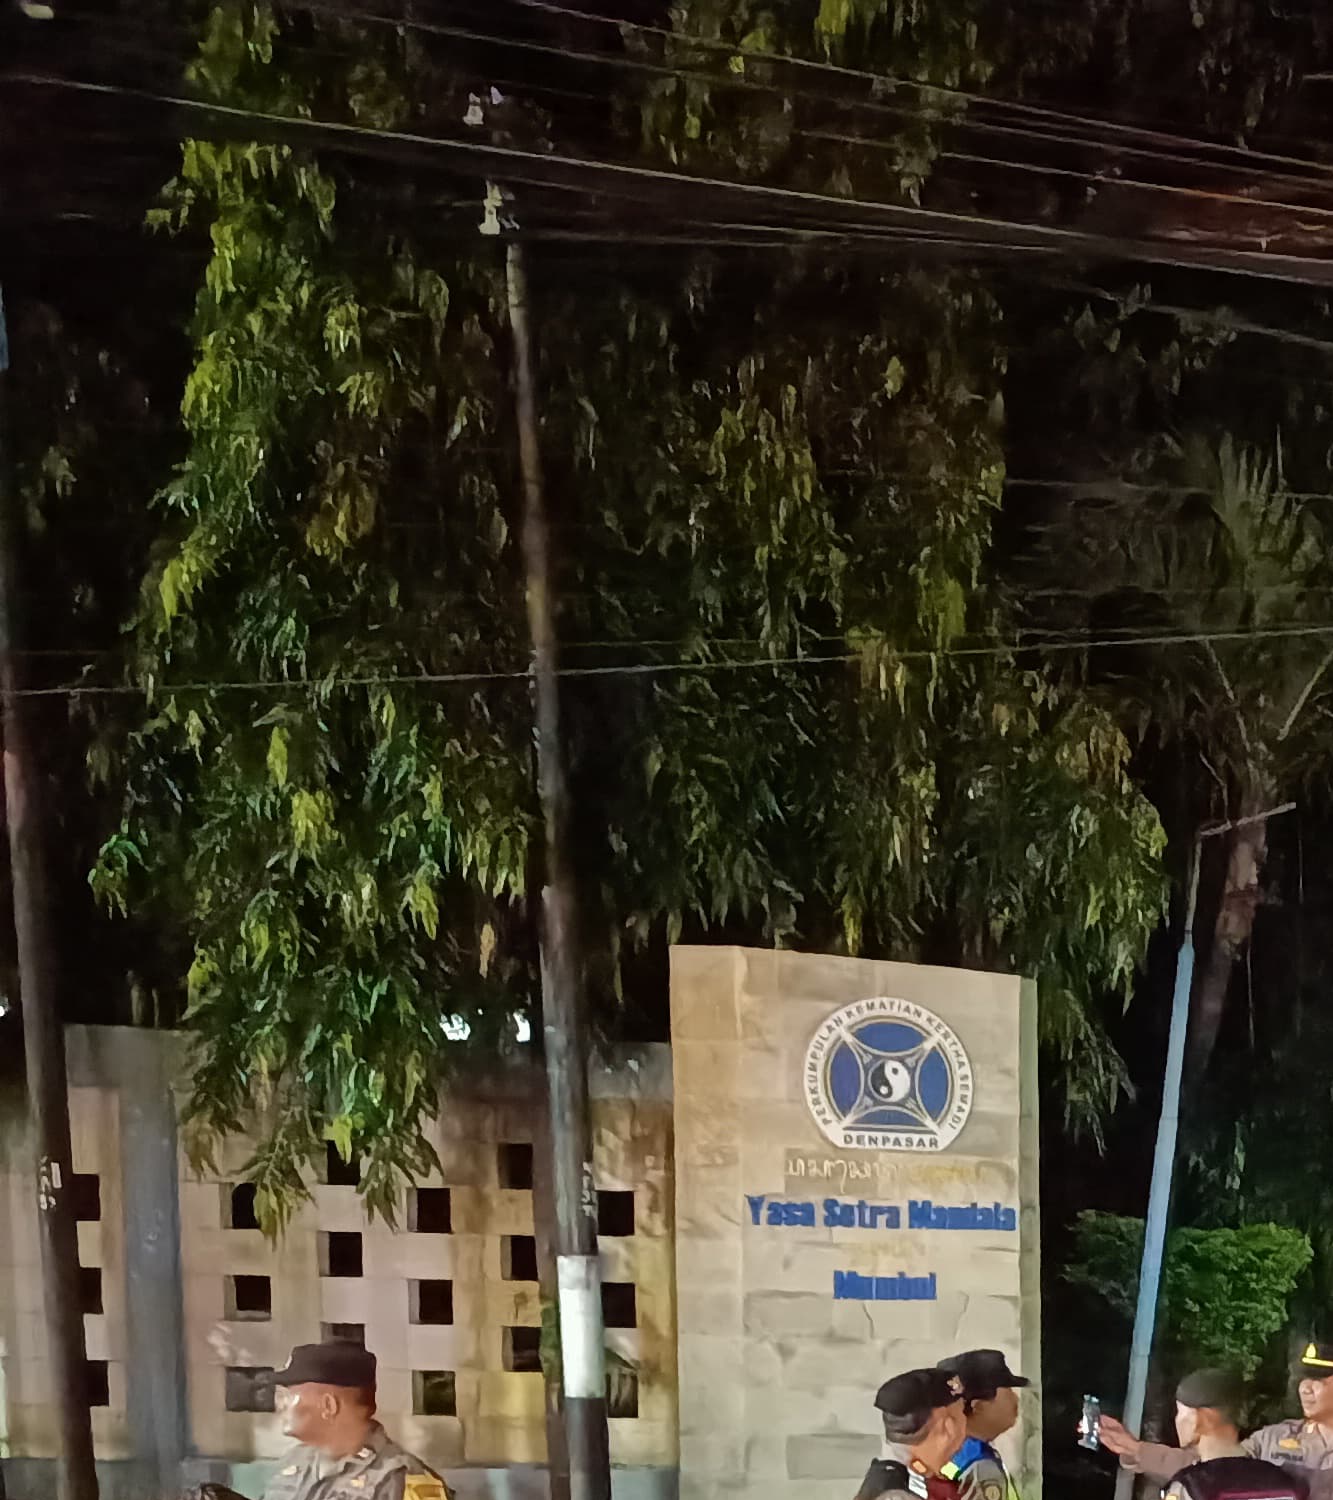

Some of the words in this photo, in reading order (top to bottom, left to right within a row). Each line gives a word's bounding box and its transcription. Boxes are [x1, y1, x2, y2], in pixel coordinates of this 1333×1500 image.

[807, 1016, 843, 1126] PERKUMPULAN
[845, 1000, 922, 1019] KEMATIAN
[926, 1015, 966, 1070] KERTHA
[948, 1073, 970, 1130] SEMADI
[843, 1134, 939, 1148] DENPASAR
